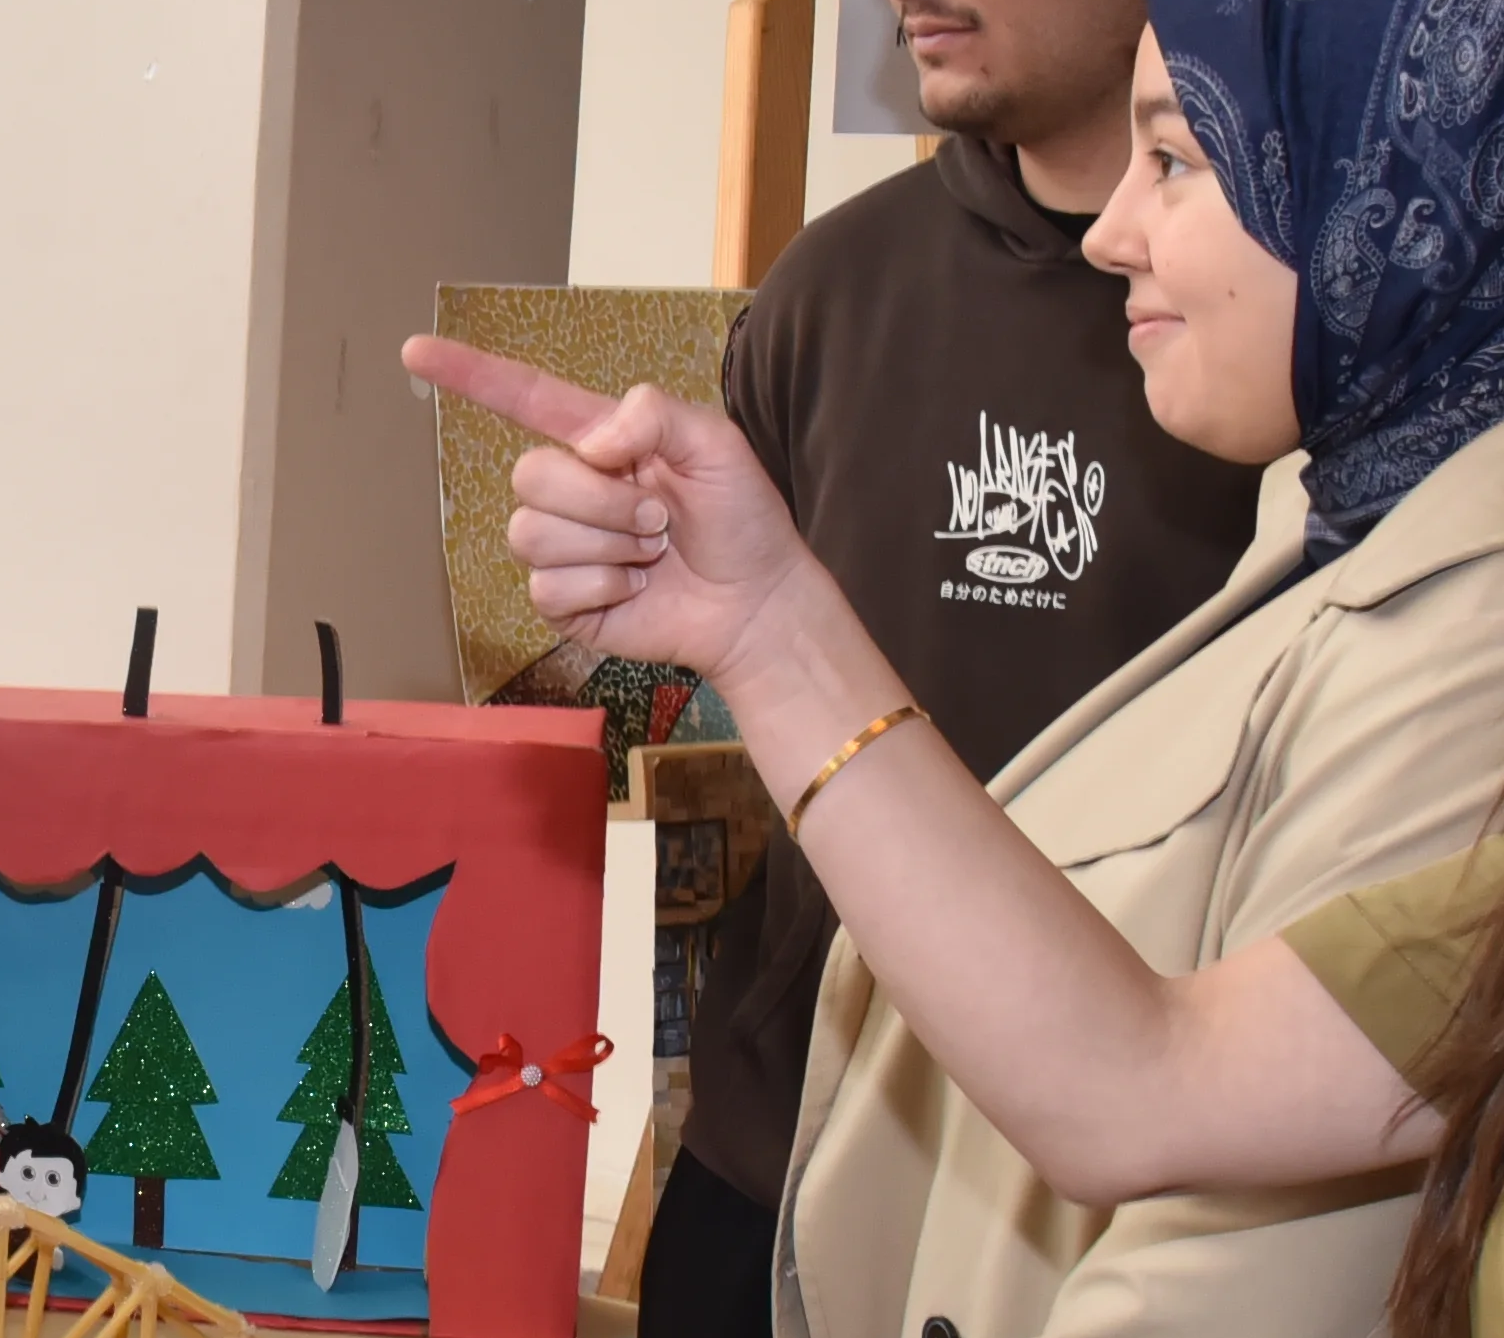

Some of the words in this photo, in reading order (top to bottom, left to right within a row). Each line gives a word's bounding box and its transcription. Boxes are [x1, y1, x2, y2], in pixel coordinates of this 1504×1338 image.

[940, 579, 1067, 610] 自分のためだけに
